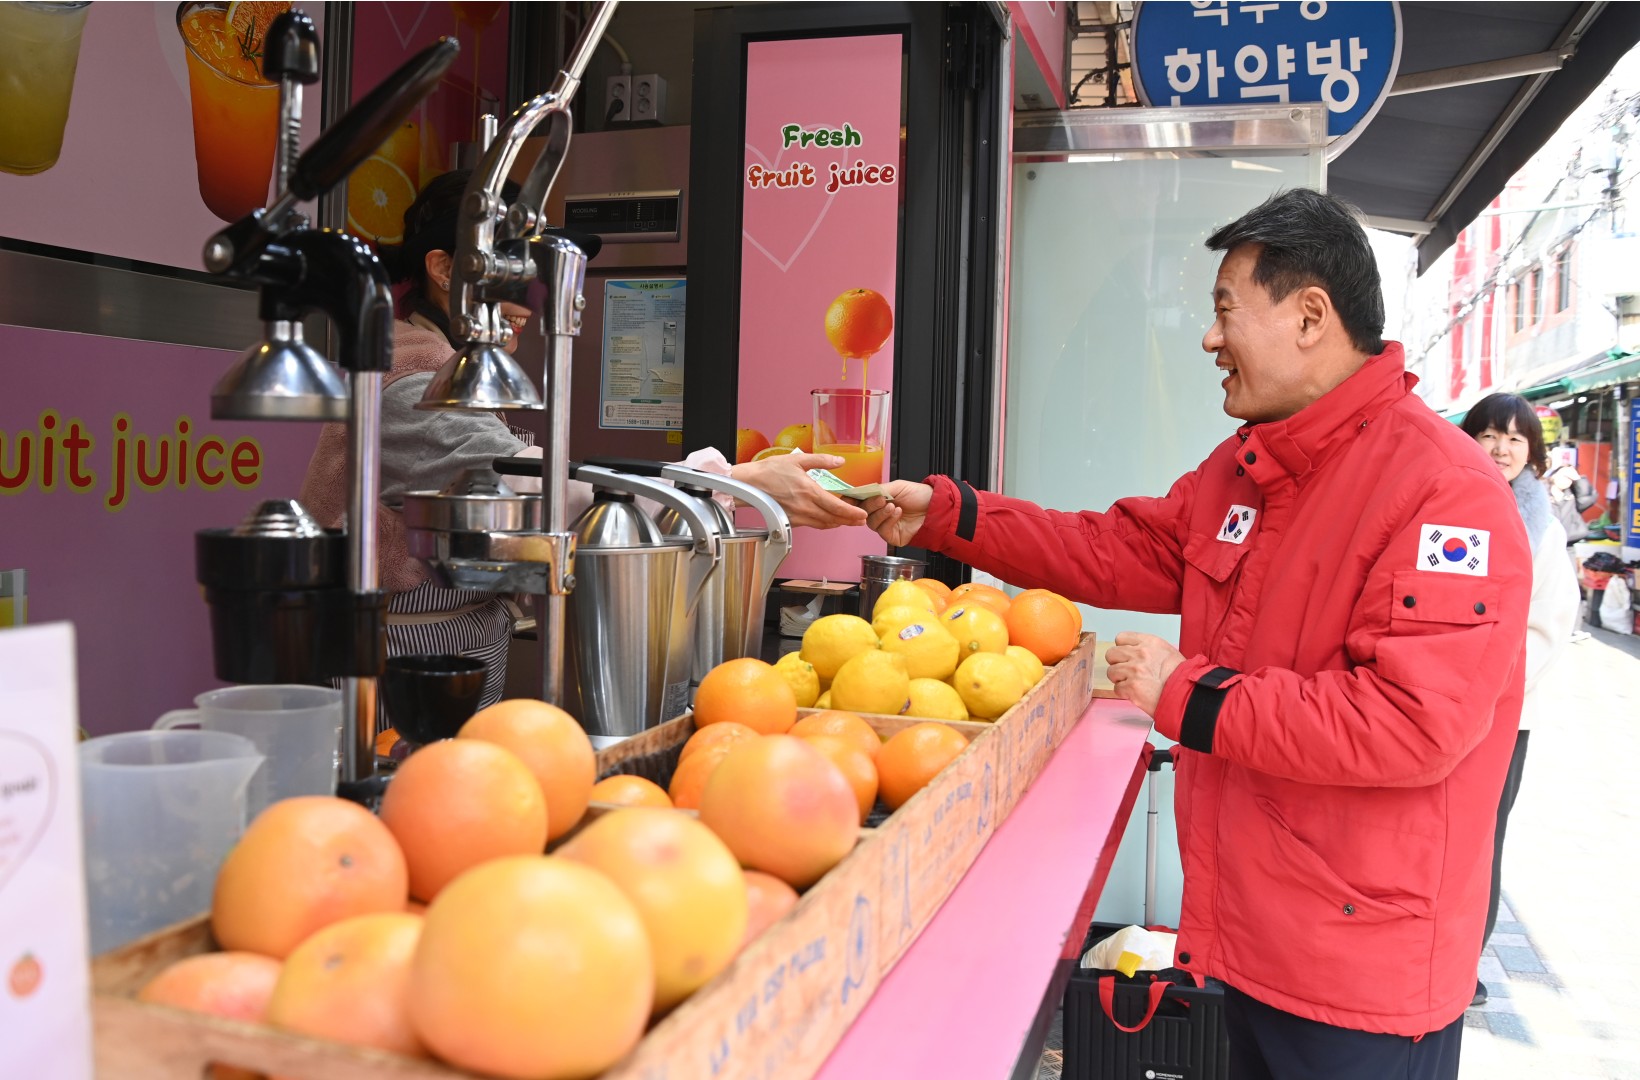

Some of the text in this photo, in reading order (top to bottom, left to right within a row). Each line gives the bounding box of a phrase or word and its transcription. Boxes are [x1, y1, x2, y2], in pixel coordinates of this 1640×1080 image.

[1164, 37, 1368, 114] 한약방
[782, 122, 862, 149] Fresh
[748, 160, 896, 193] fruit juice
[107, 416, 262, 508] juice
